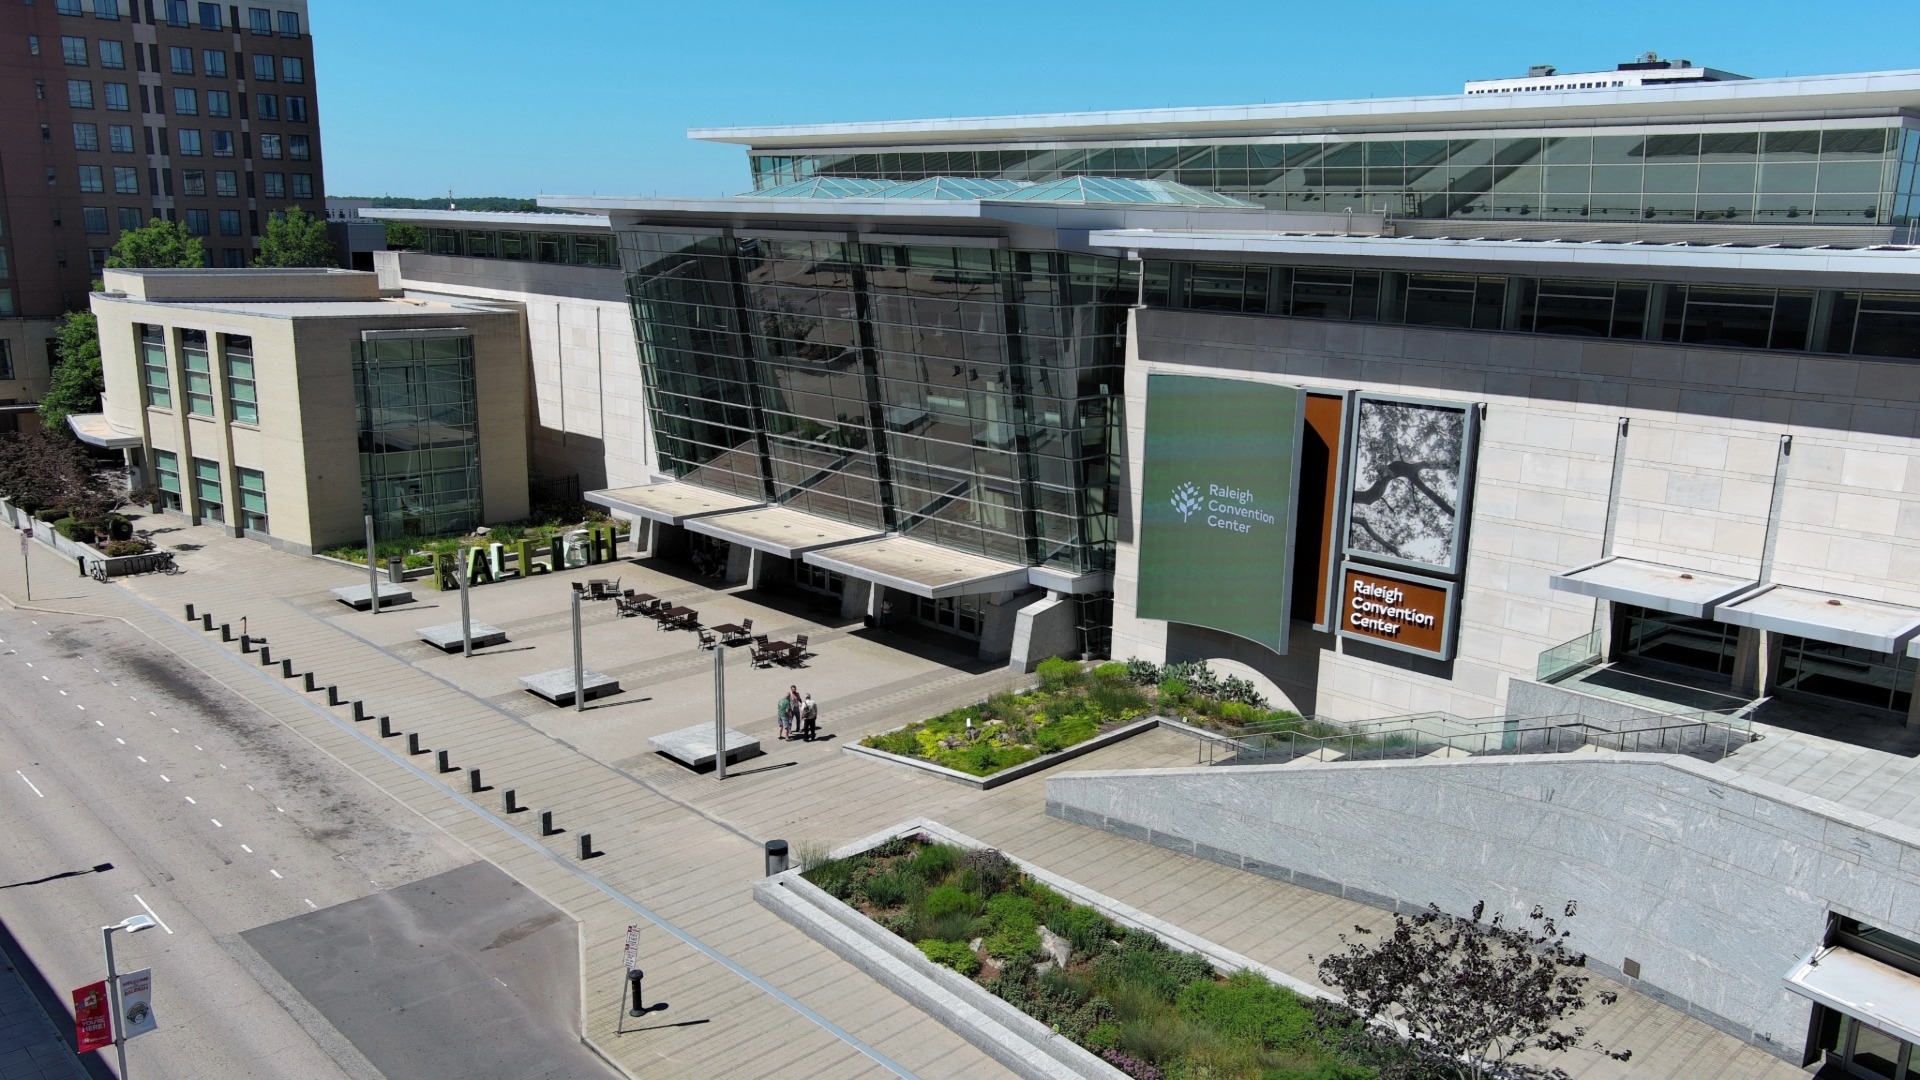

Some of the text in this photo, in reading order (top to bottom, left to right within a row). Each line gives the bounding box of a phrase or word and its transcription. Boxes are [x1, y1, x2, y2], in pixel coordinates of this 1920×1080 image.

[1209, 484, 1253, 505] Raleigh
[1208, 500, 1275, 524] Convention
[1207, 515, 1251, 533] Center
[1353, 580, 1403, 604] Raleigh
[1352, 597, 1434, 626] Convention
[1350, 612, 1400, 634] Center
[122, 977, 149, 987] WELCOME
[124, 985, 149, 997] RALEIGH
[81, 1022, 106, 1033] HERE!
